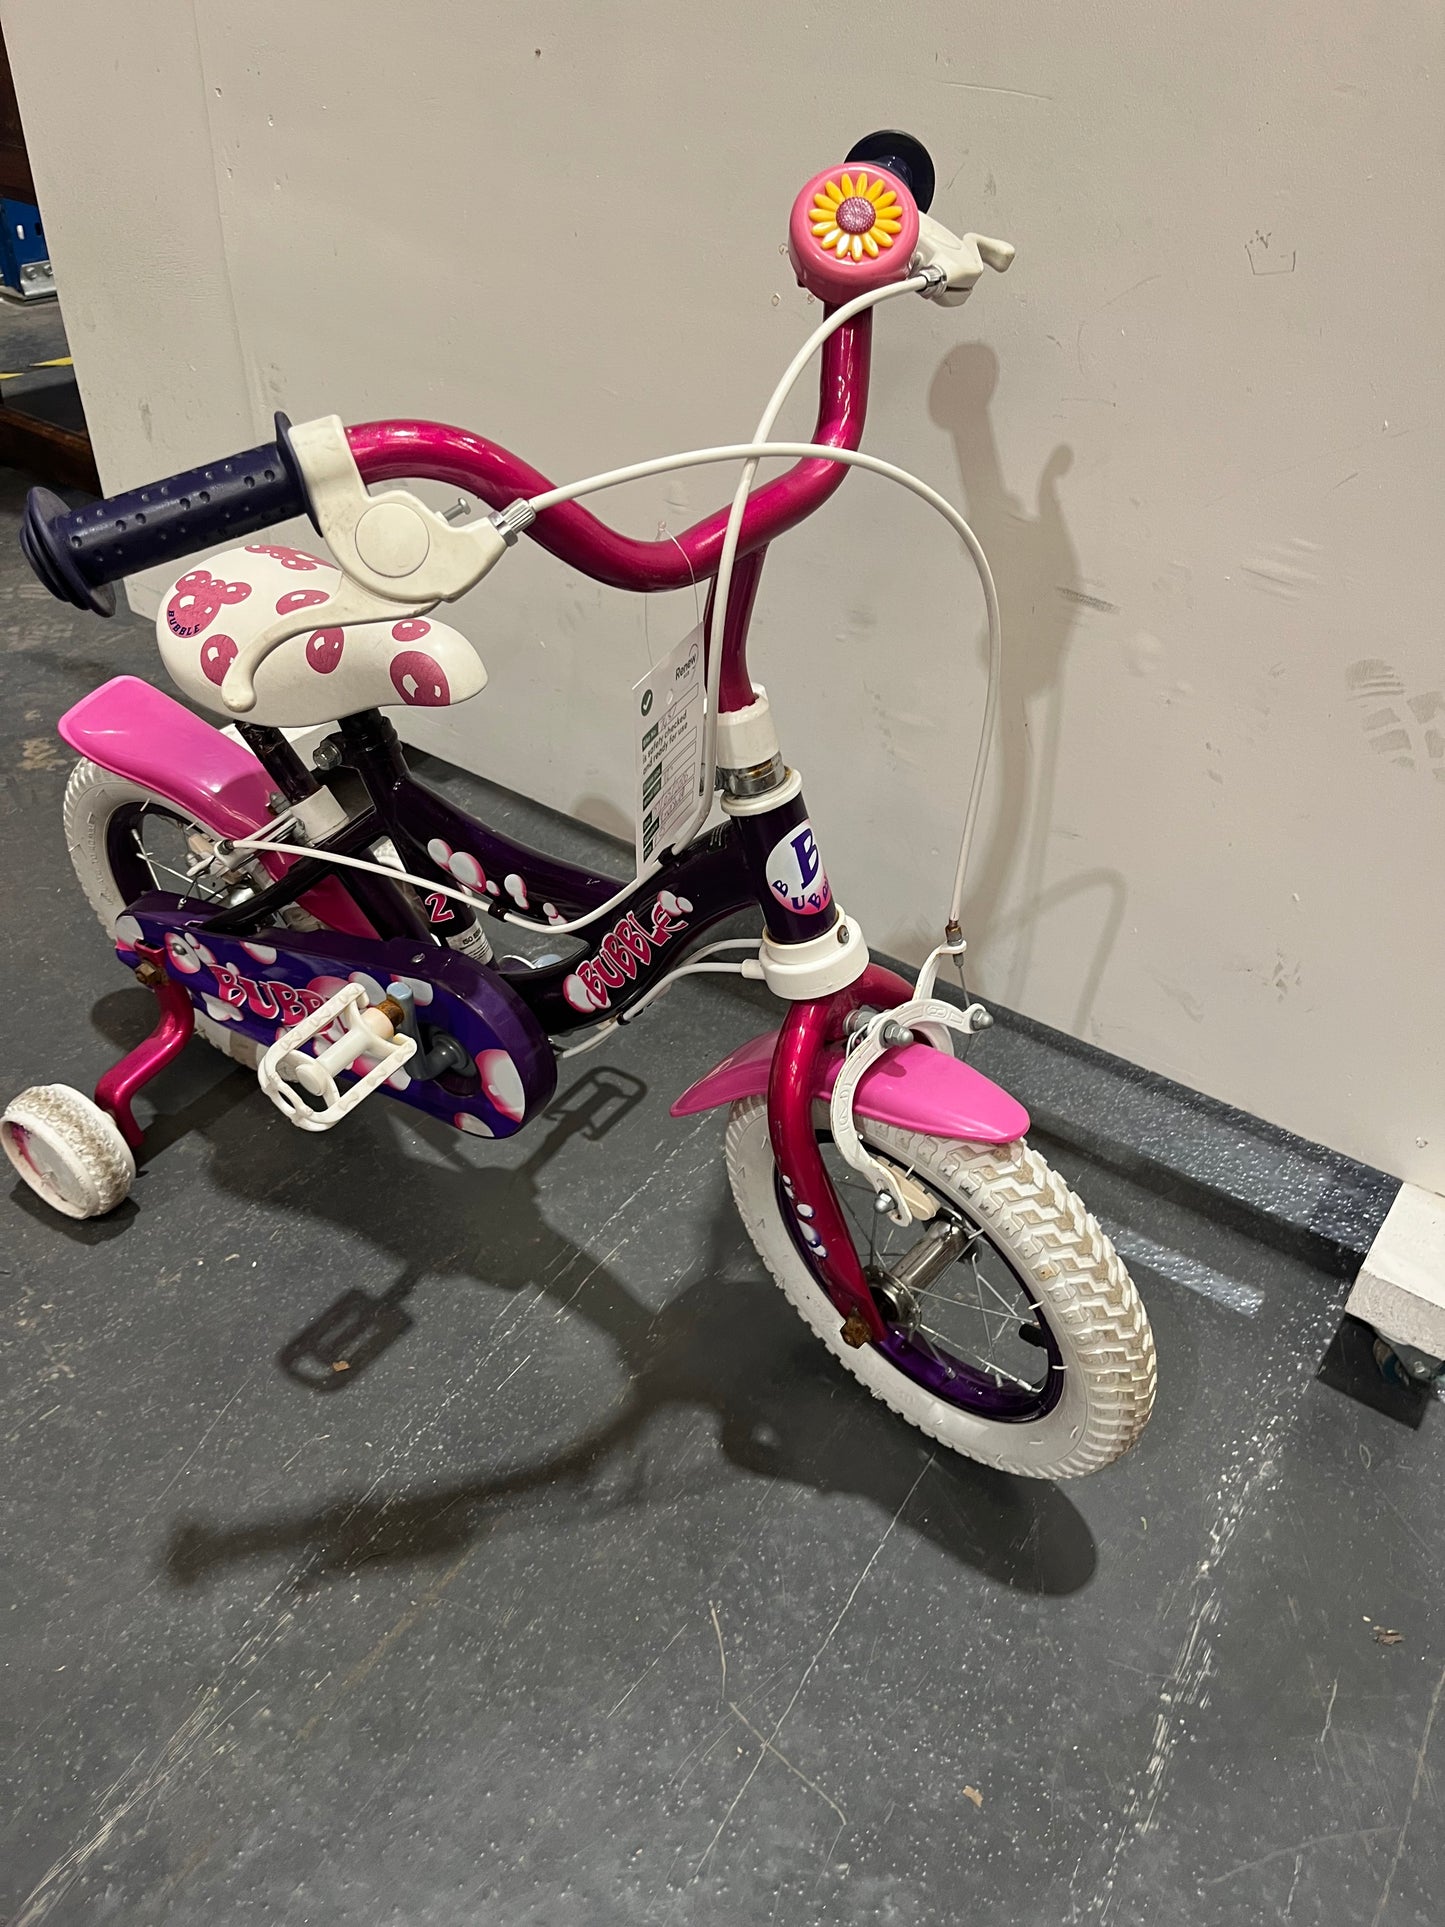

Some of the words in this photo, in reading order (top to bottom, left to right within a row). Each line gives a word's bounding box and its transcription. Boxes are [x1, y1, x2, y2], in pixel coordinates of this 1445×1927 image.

[168, 610, 201, 636] BUBBLE
[675, 652, 697, 681] Renew
[664, 709, 688, 739] checked
[790, 828, 819, 889] B
[575, 900, 690, 1008] BUBBLE
